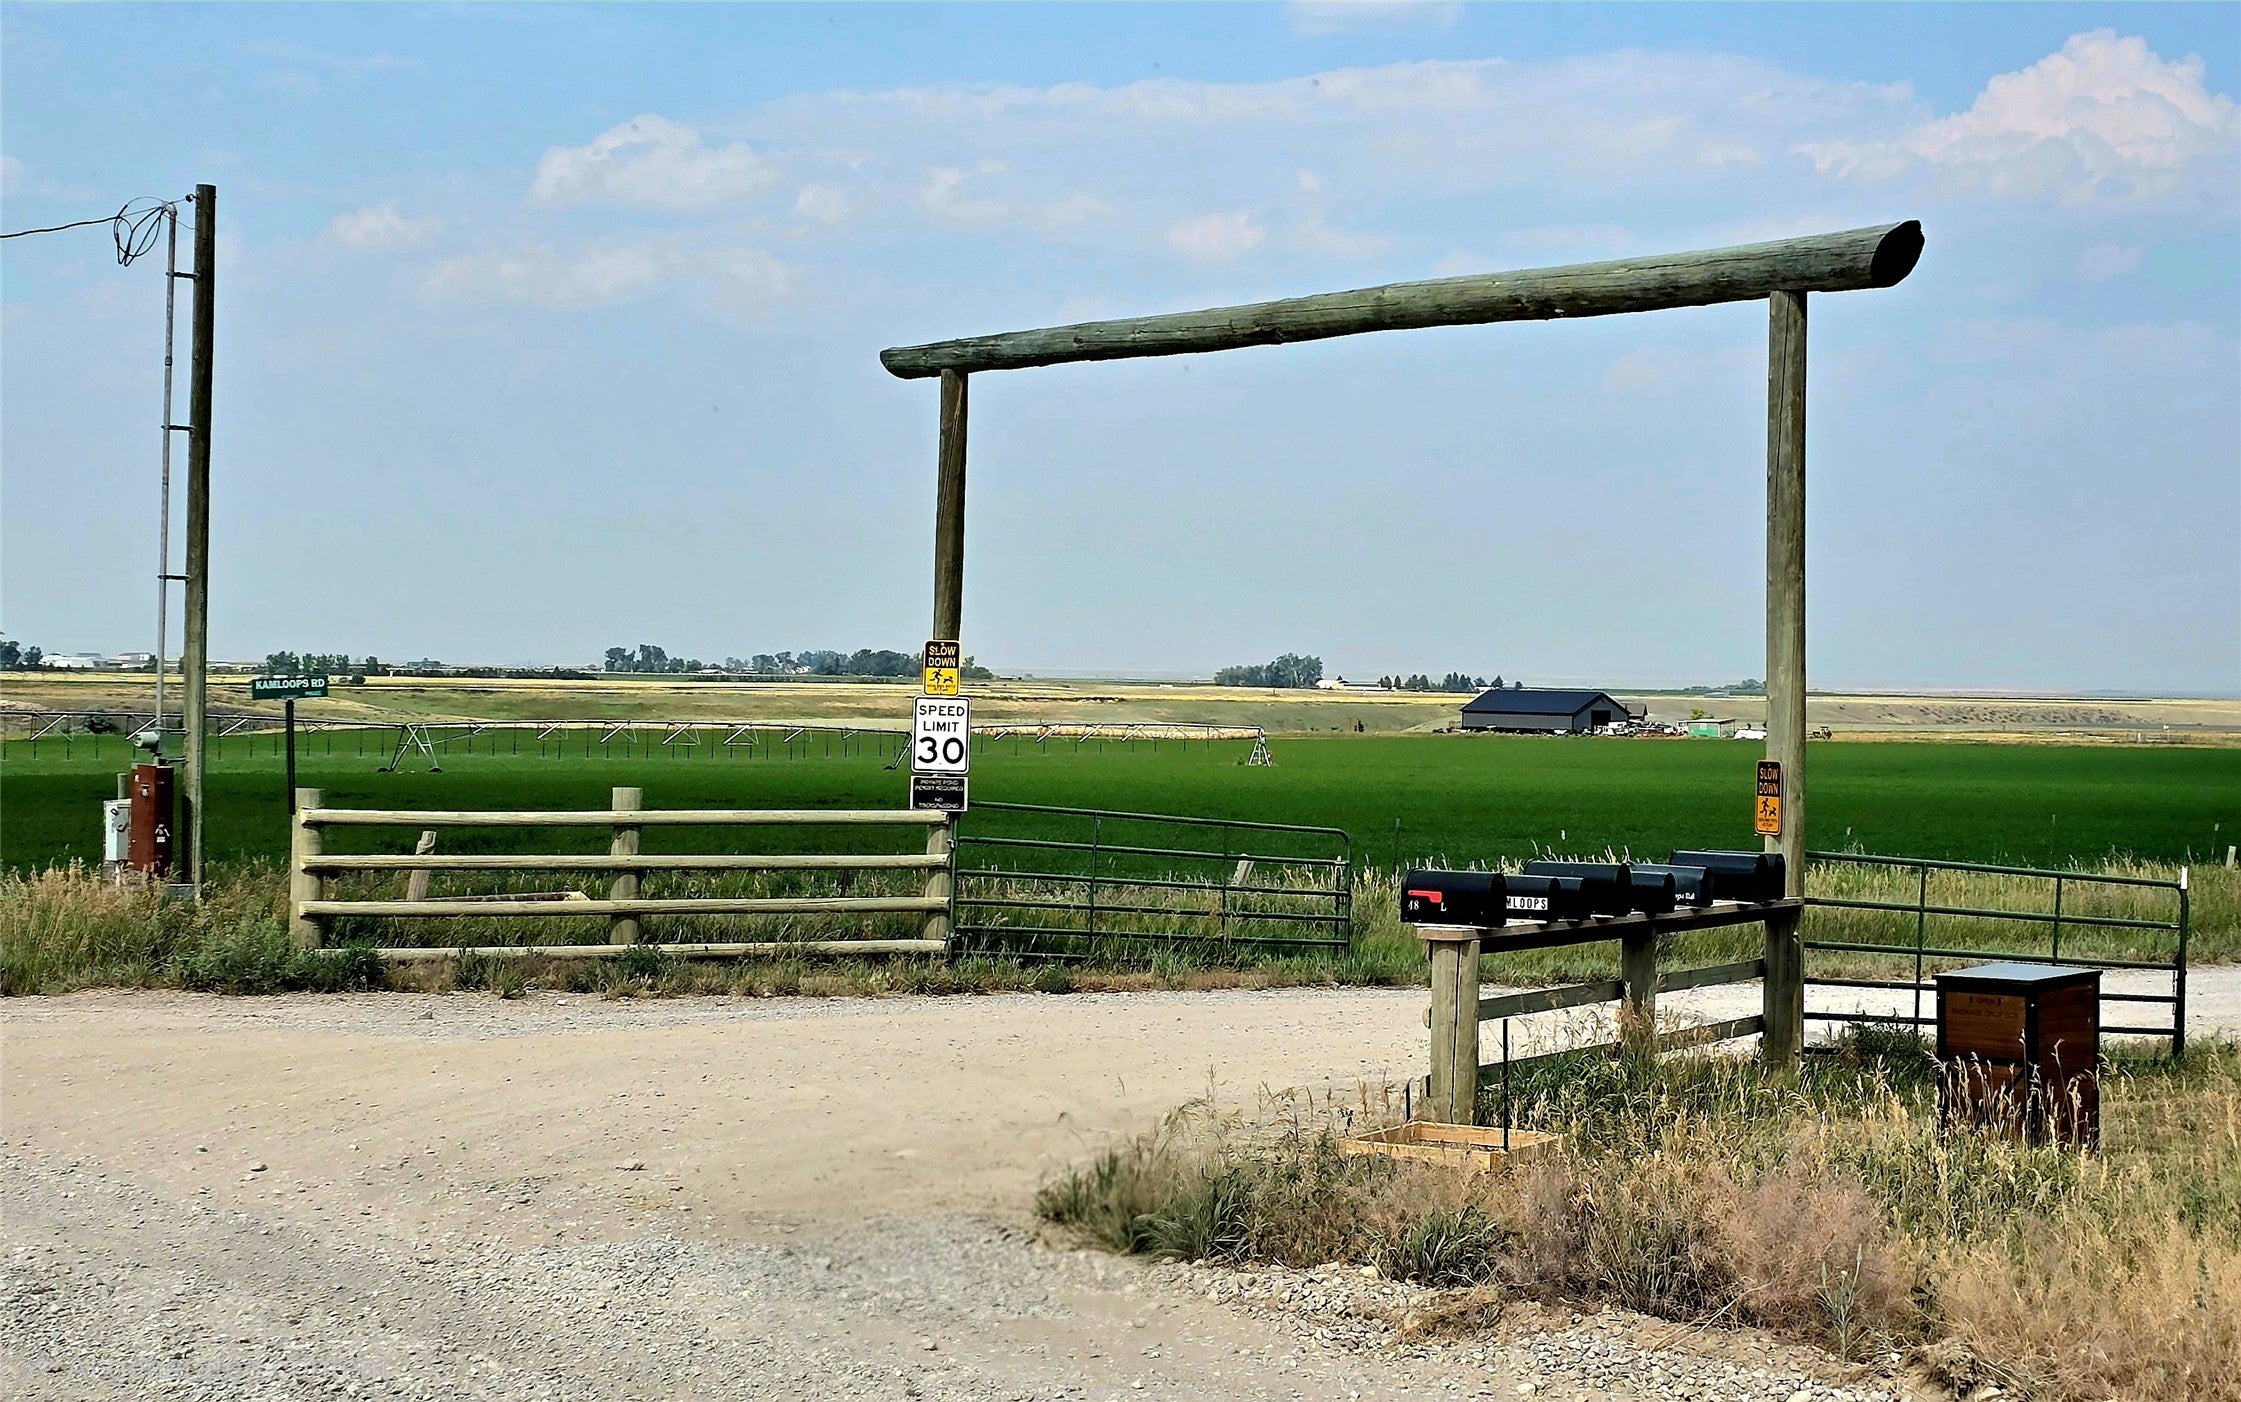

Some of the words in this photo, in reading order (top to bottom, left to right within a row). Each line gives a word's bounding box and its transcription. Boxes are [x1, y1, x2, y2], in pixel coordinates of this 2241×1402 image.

[928, 645, 957, 656] SLOW
[928, 657, 956, 667] DOWN
[255, 679, 309, 690] KAMLOOPS
[311, 679, 325, 688] RD
[919, 705, 965, 717] SPEED
[923, 721, 959, 733] LIMIT
[917, 736, 964, 764] 30
[1759, 768, 1779, 780] SLOW
[1758, 782, 1779, 795] DOWN
